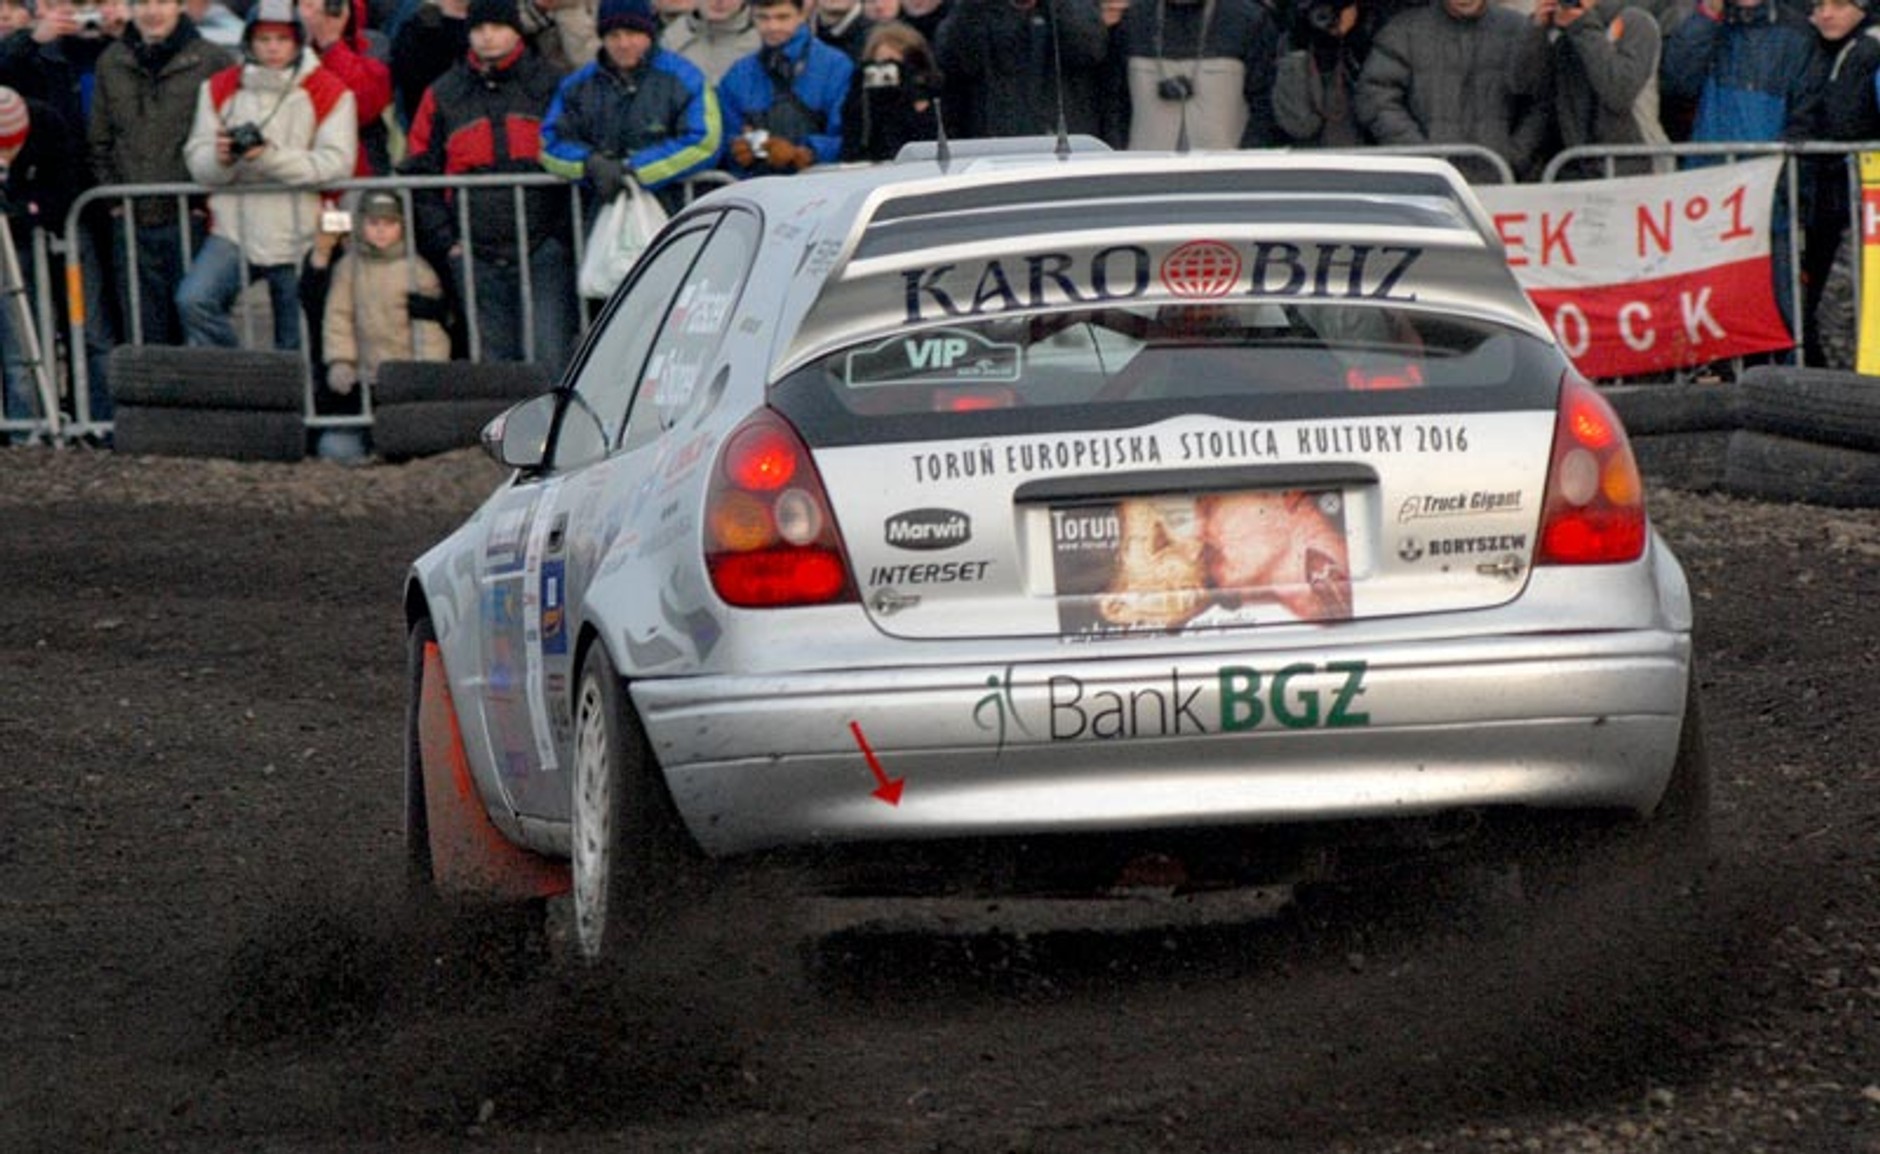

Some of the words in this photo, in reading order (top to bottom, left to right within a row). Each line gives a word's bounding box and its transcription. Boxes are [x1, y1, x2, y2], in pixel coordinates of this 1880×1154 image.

[902, 244, 1152, 324] KARO
[1246, 240, 1424, 302] BHZ
[905, 338, 968, 369] VIP
[1007, 435, 1161, 473] EUROPEJSKA
[1179, 428, 1279, 460] STOLICA
[1297, 425, 1401, 454] KULTURY
[1416, 425, 1468, 452] 2016
[1424, 494, 1466, 512] Truck
[889, 516, 966, 541] Marwit
[1429, 534, 1526, 556] BORYSZEW
[869, 561, 990, 586] INTERSET
[1049, 667, 1206, 740] Bank
